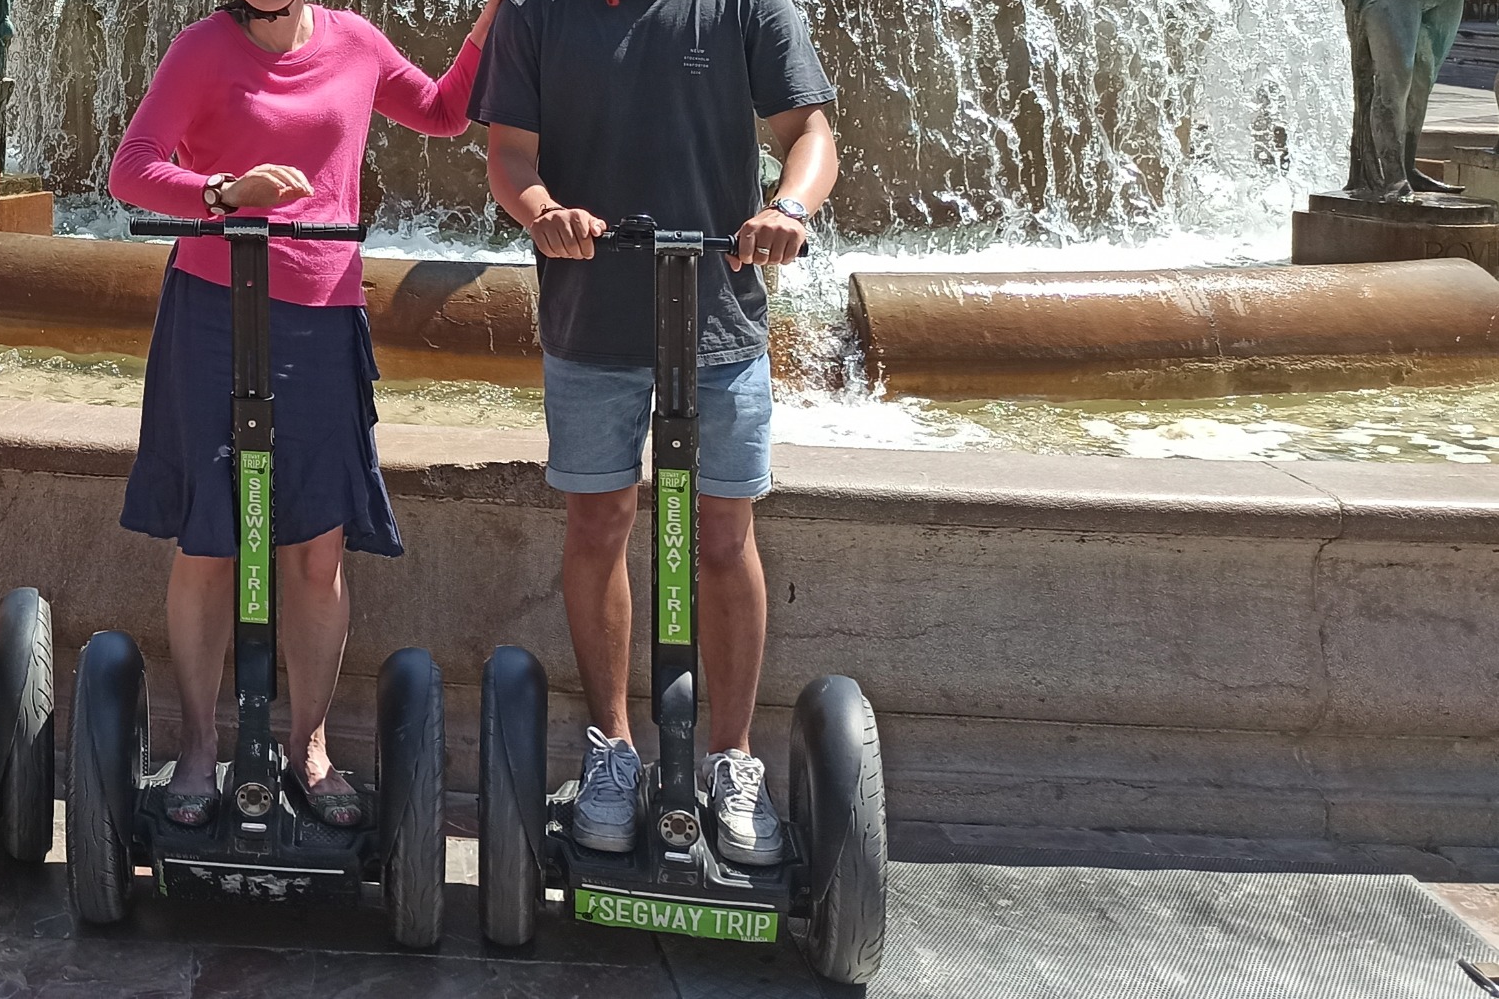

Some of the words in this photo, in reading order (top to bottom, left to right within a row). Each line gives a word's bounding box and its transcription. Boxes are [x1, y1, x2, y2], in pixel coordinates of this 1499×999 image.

[243, 459, 260, 468] TRIP
[660, 478, 679, 487] TRIP
[245, 477, 264, 552] SEGWAY
[663, 496, 684, 573] SEGWAY
[247, 565, 260, 614] TRIP
[666, 586, 681, 636] TRIP
[599, 896, 703, 932] SEGWAY
[711, 909, 770, 937] TRIP
